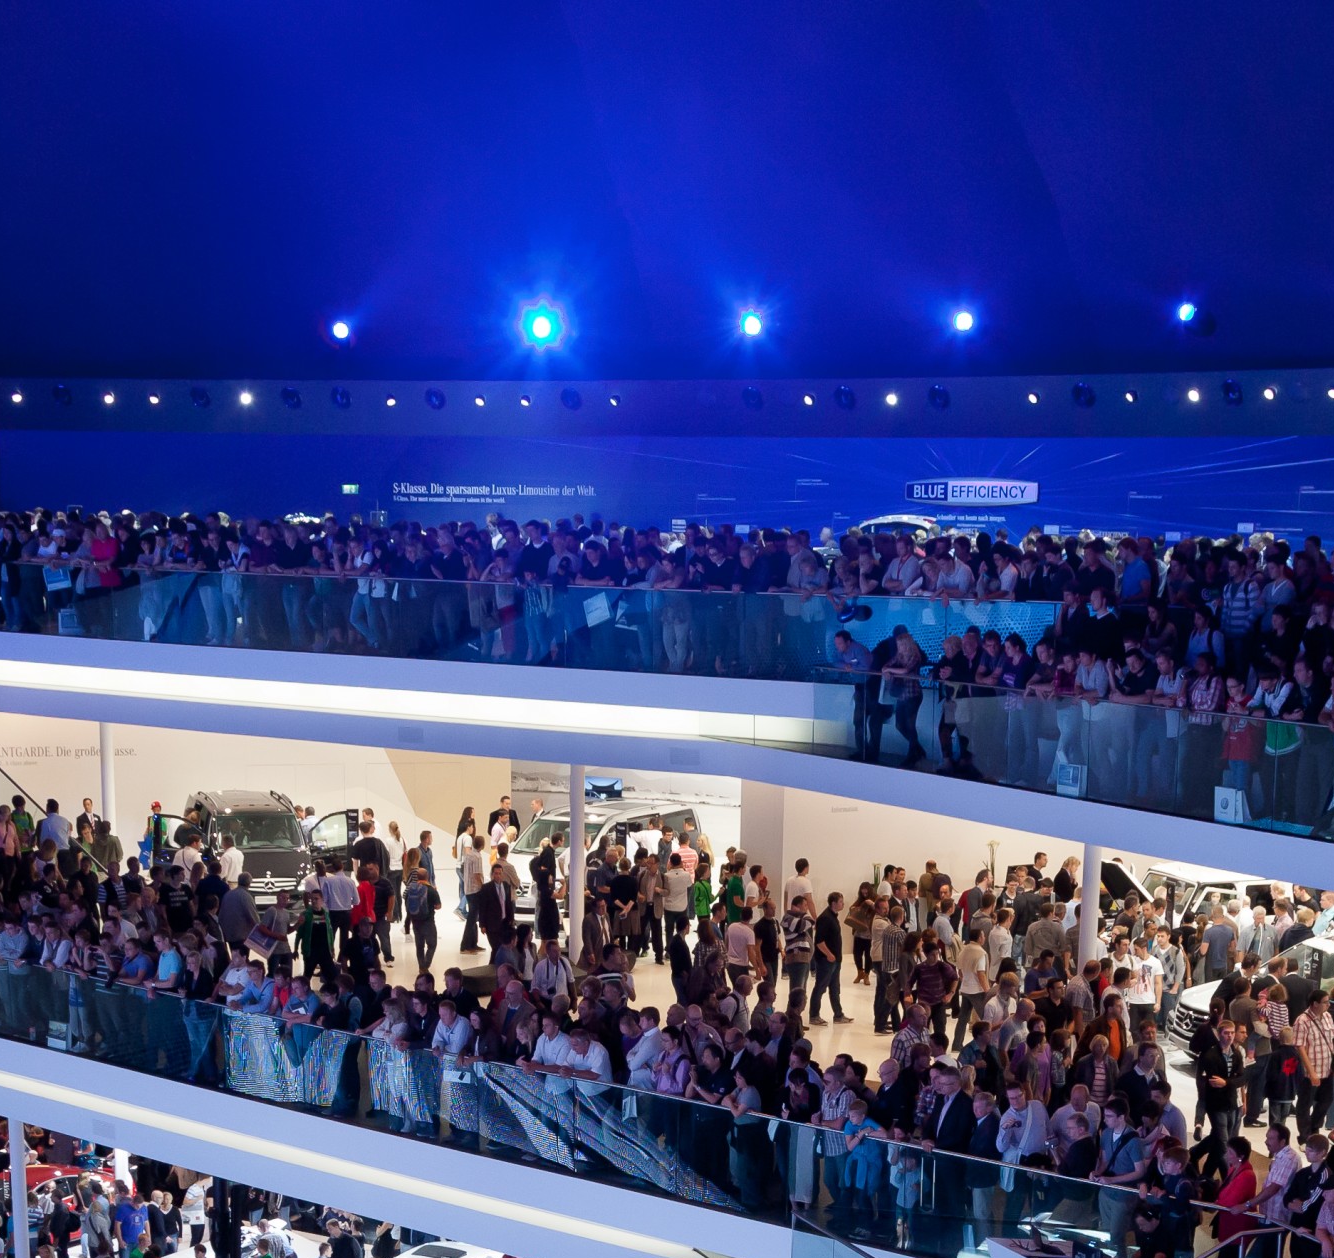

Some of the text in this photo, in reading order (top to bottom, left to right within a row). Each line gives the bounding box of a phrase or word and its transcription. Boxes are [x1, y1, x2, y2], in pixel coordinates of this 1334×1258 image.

[392, 482, 597, 497] S-Klasse. Die sparsamste Luxus-Limousine der Welt.
[913, 484, 1028, 499] BLUE EFFICIENCY
[55, 746, 72, 757] Die
[74, 746, 101, 760] große
